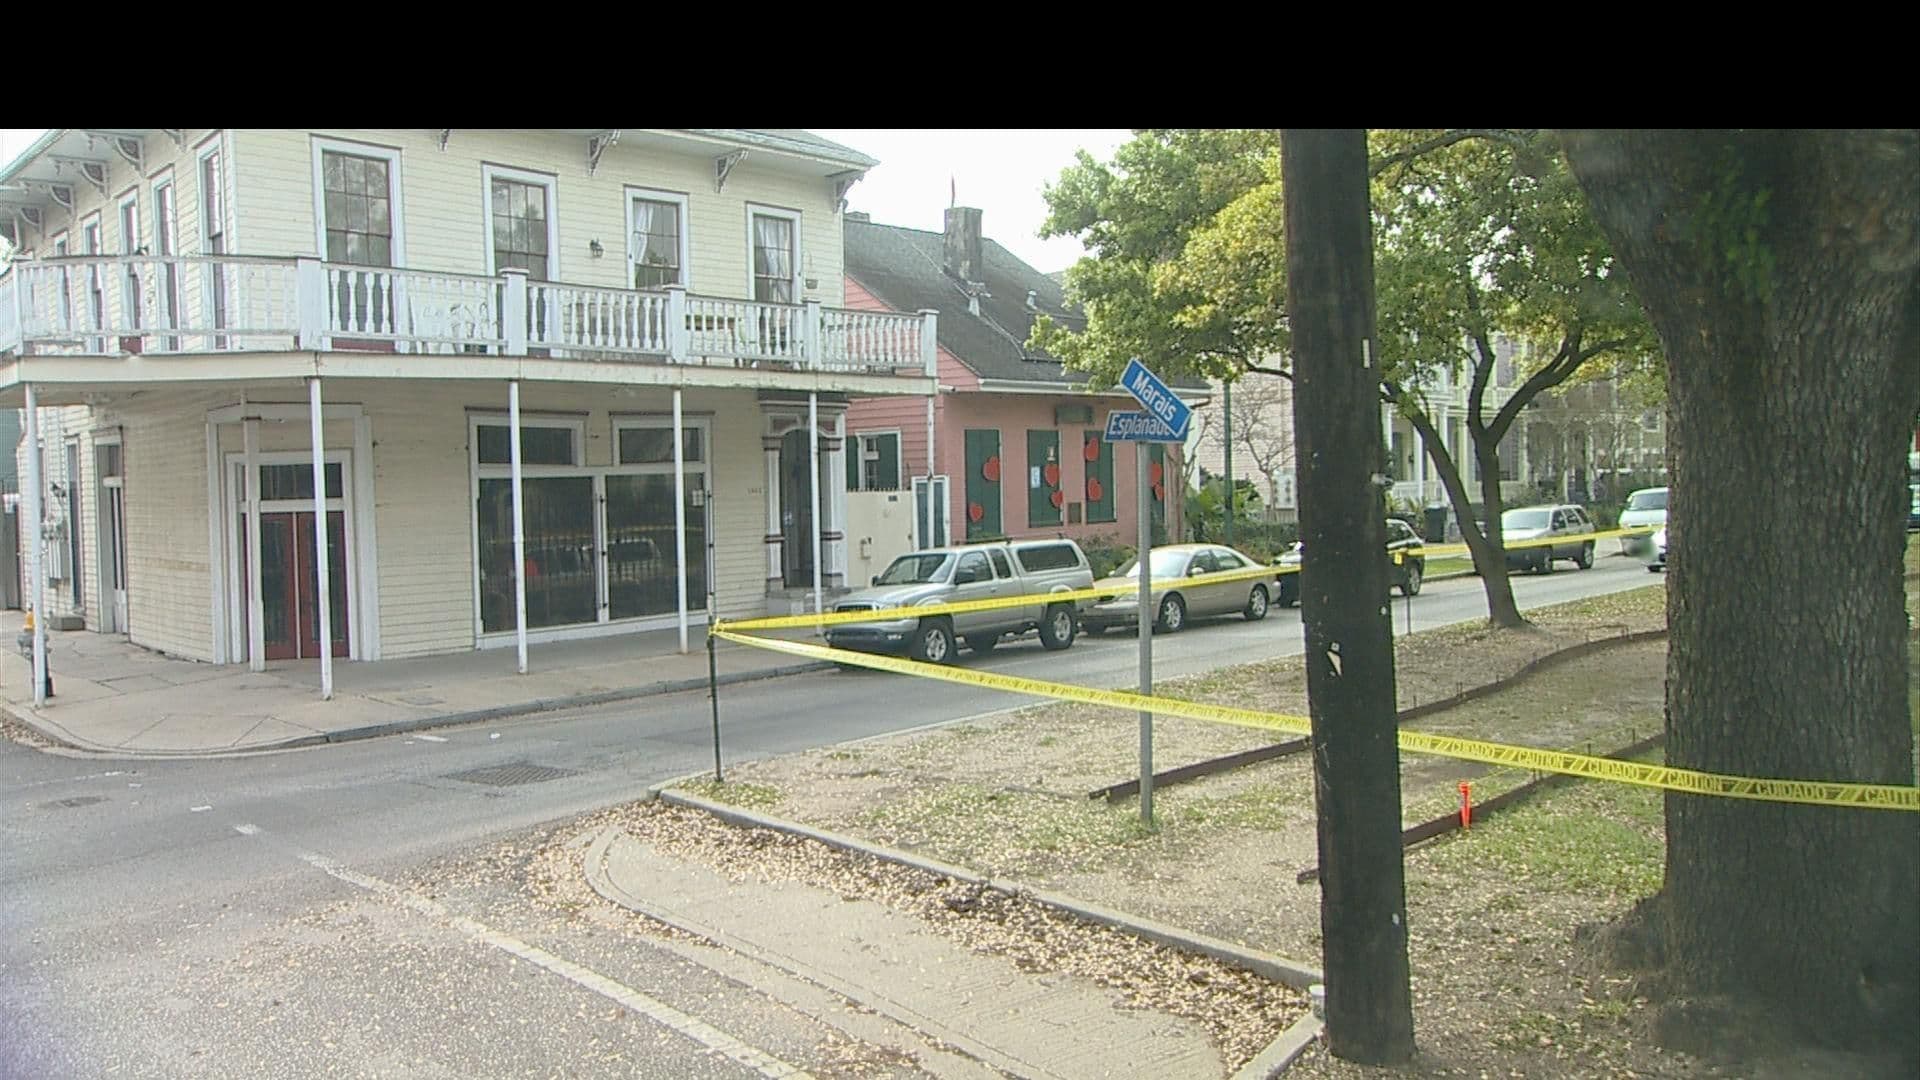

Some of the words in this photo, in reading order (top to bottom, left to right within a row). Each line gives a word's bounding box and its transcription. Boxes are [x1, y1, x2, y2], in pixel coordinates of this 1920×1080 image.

[1132, 370, 1177, 421] Marais
[1517, 750, 1564, 769] CAUTION
[1588, 759, 1640, 779] CUIDADO
[1667, 770, 1723, 792] CAUTION
[1755, 782, 1827, 800] CUIDADO
